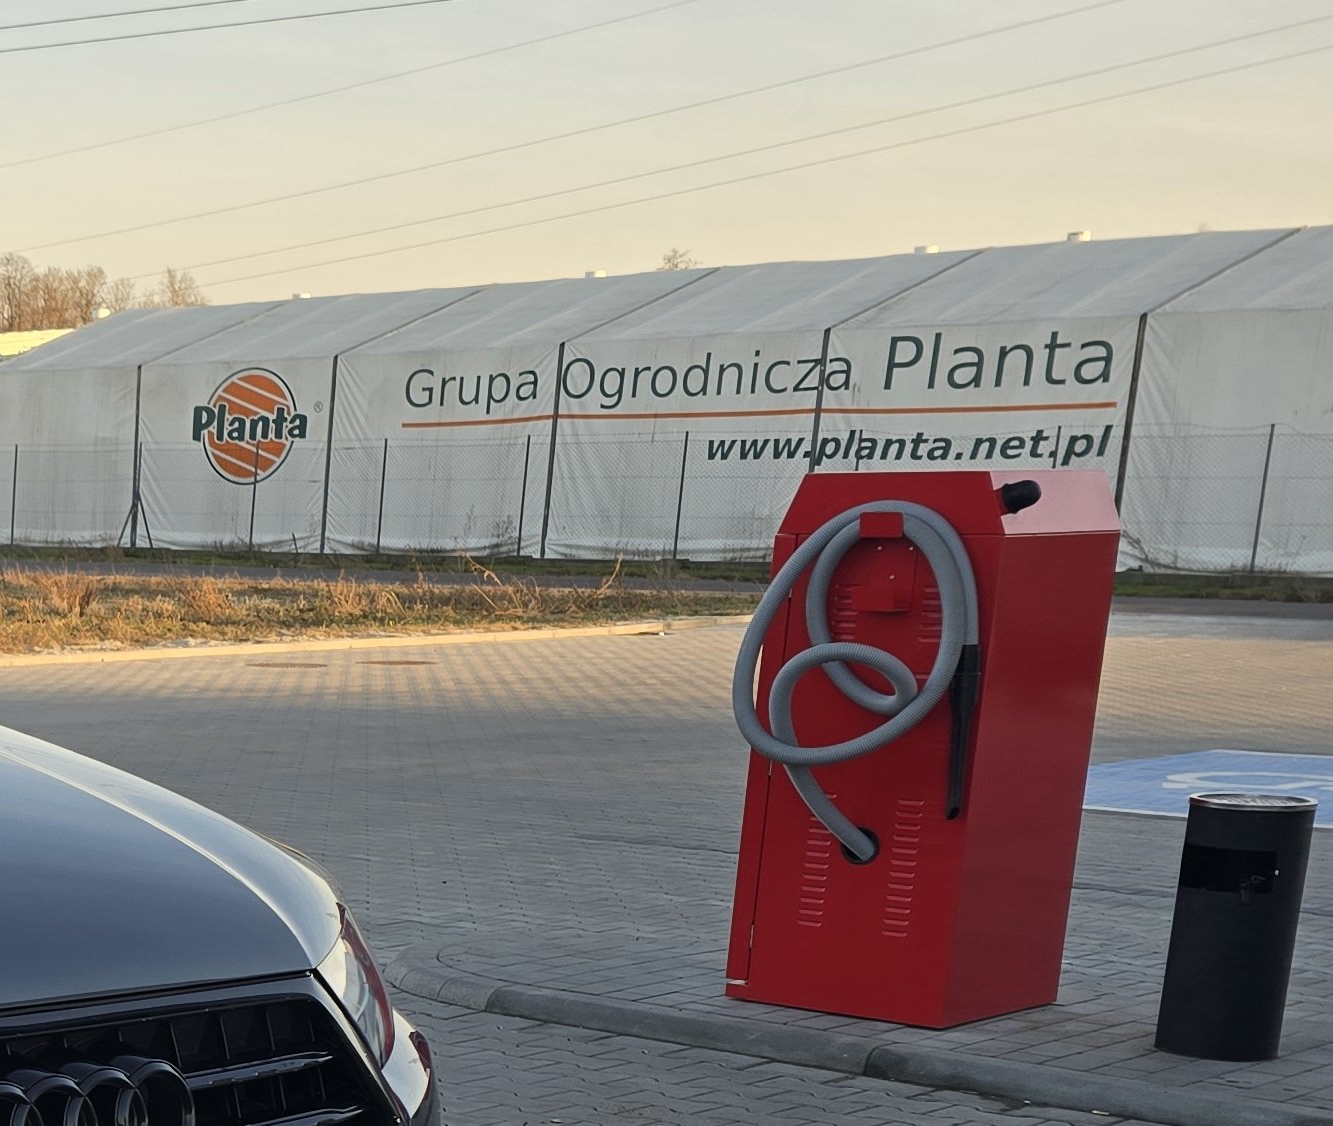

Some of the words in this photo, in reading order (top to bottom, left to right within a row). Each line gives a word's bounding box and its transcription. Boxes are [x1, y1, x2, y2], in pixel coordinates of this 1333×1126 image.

[405, 368, 539, 415] Grupa
[562, 350, 852, 409] Ogrodnicza
[883, 331, 1114, 390] Planta
[192, 404, 308, 442] Planta
[707, 424, 1113, 466] www.planta.net.pl
